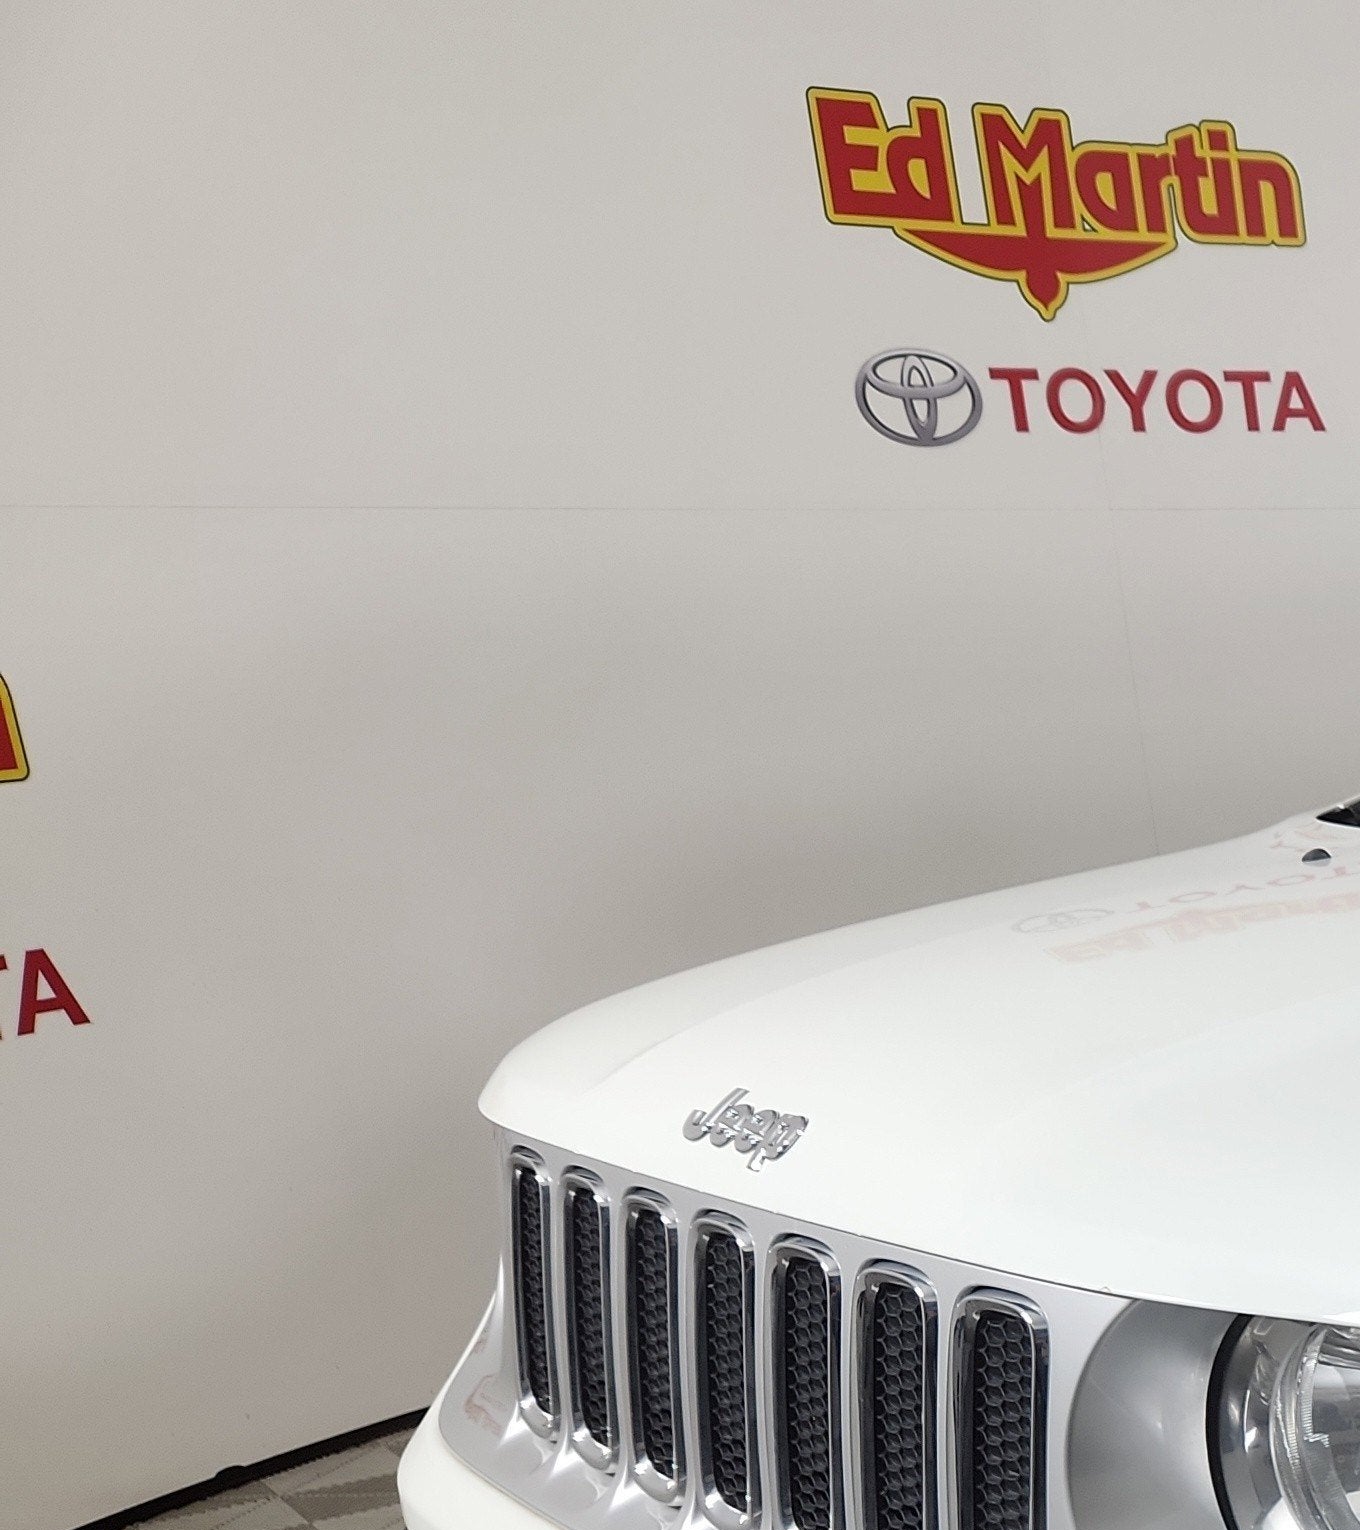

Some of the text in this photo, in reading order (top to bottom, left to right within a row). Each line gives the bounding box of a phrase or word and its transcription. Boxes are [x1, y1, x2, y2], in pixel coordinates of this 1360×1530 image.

[807, 89, 1305, 246] Ed Martin
[989, 367, 1326, 433] TOYOTA
[682, 1087, 809, 1172] Jeep
